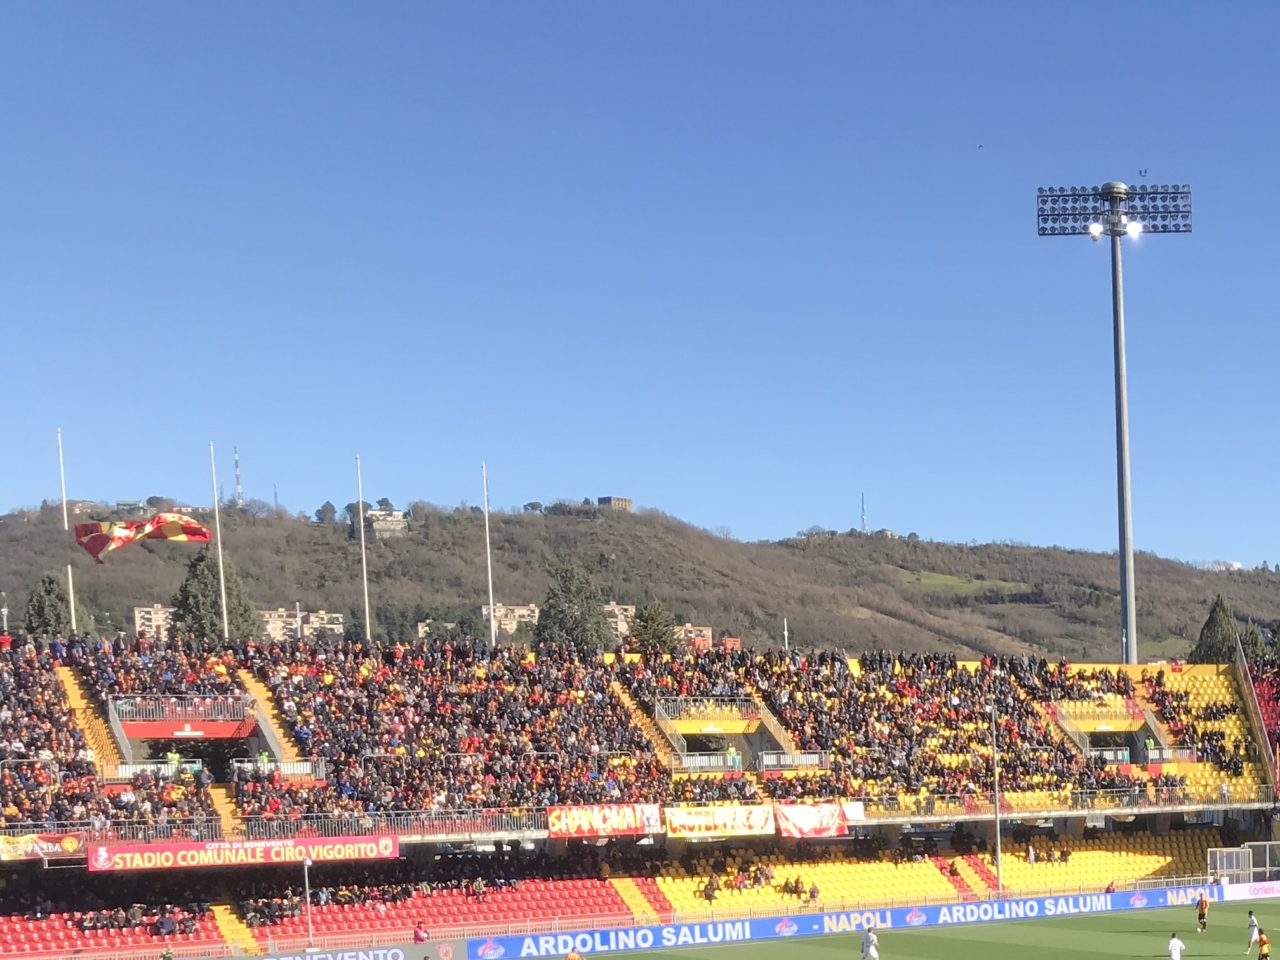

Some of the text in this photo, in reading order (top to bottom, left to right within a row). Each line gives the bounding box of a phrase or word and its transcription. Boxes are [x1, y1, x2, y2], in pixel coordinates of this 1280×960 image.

[113, 843, 377, 869] STADIO COMUNALE CIRO VIGORITO
[233, 840, 242, 849] DI
[244, 839, 295, 848] BENEVENTO
[1167, 884, 1219, 906] NAPOLI
[823, 910, 892, 933] NAPOLI
[937, 894, 1112, 925] ARDOLINO SALUMI
[520, 921, 751, 958] ARDOLINO SALUMI
